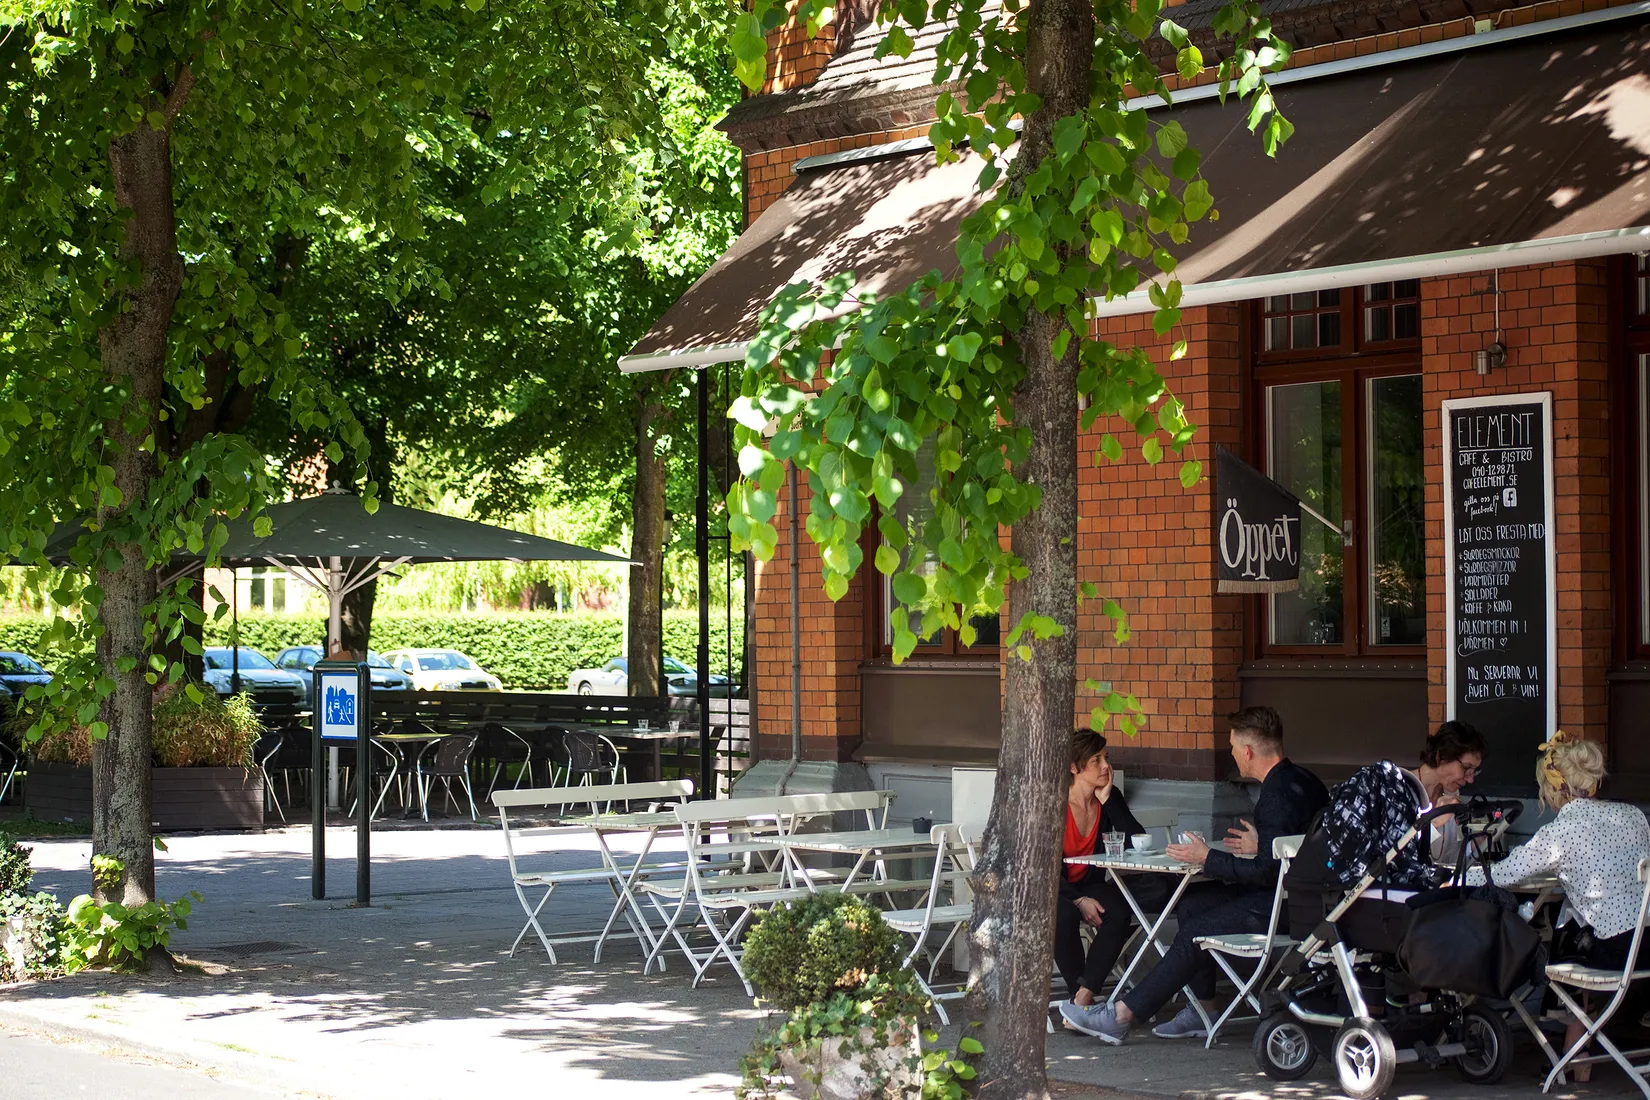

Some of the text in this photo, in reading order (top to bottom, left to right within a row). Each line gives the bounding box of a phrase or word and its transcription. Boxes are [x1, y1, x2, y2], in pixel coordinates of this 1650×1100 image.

[1457, 412, 1534, 449] ELEMENT
[1482, 452, 1490, 464] &
[1501, 450, 1533, 463] BISTRO
[1219, 498, 1298, 580] Öppet
[1459, 523, 1545, 543] LÅT OSS FRESTA MED
[1464, 587, 1498, 601] SALLADER
[1464, 602, 1483, 614] KAFFE
[1493, 600, 1513, 613] KAKA
[1458, 618, 1506, 635] VÄLKOMMEN
[1510, 619, 1519, 634] IN
[1484, 664, 1522, 680] SERVERAR
[1527, 666, 1538, 680] VI
[1468, 683, 1489, 698] ÄVEN
[1495, 681, 1506, 697] ÖL
[1520, 684, 1539, 697] VIN!
